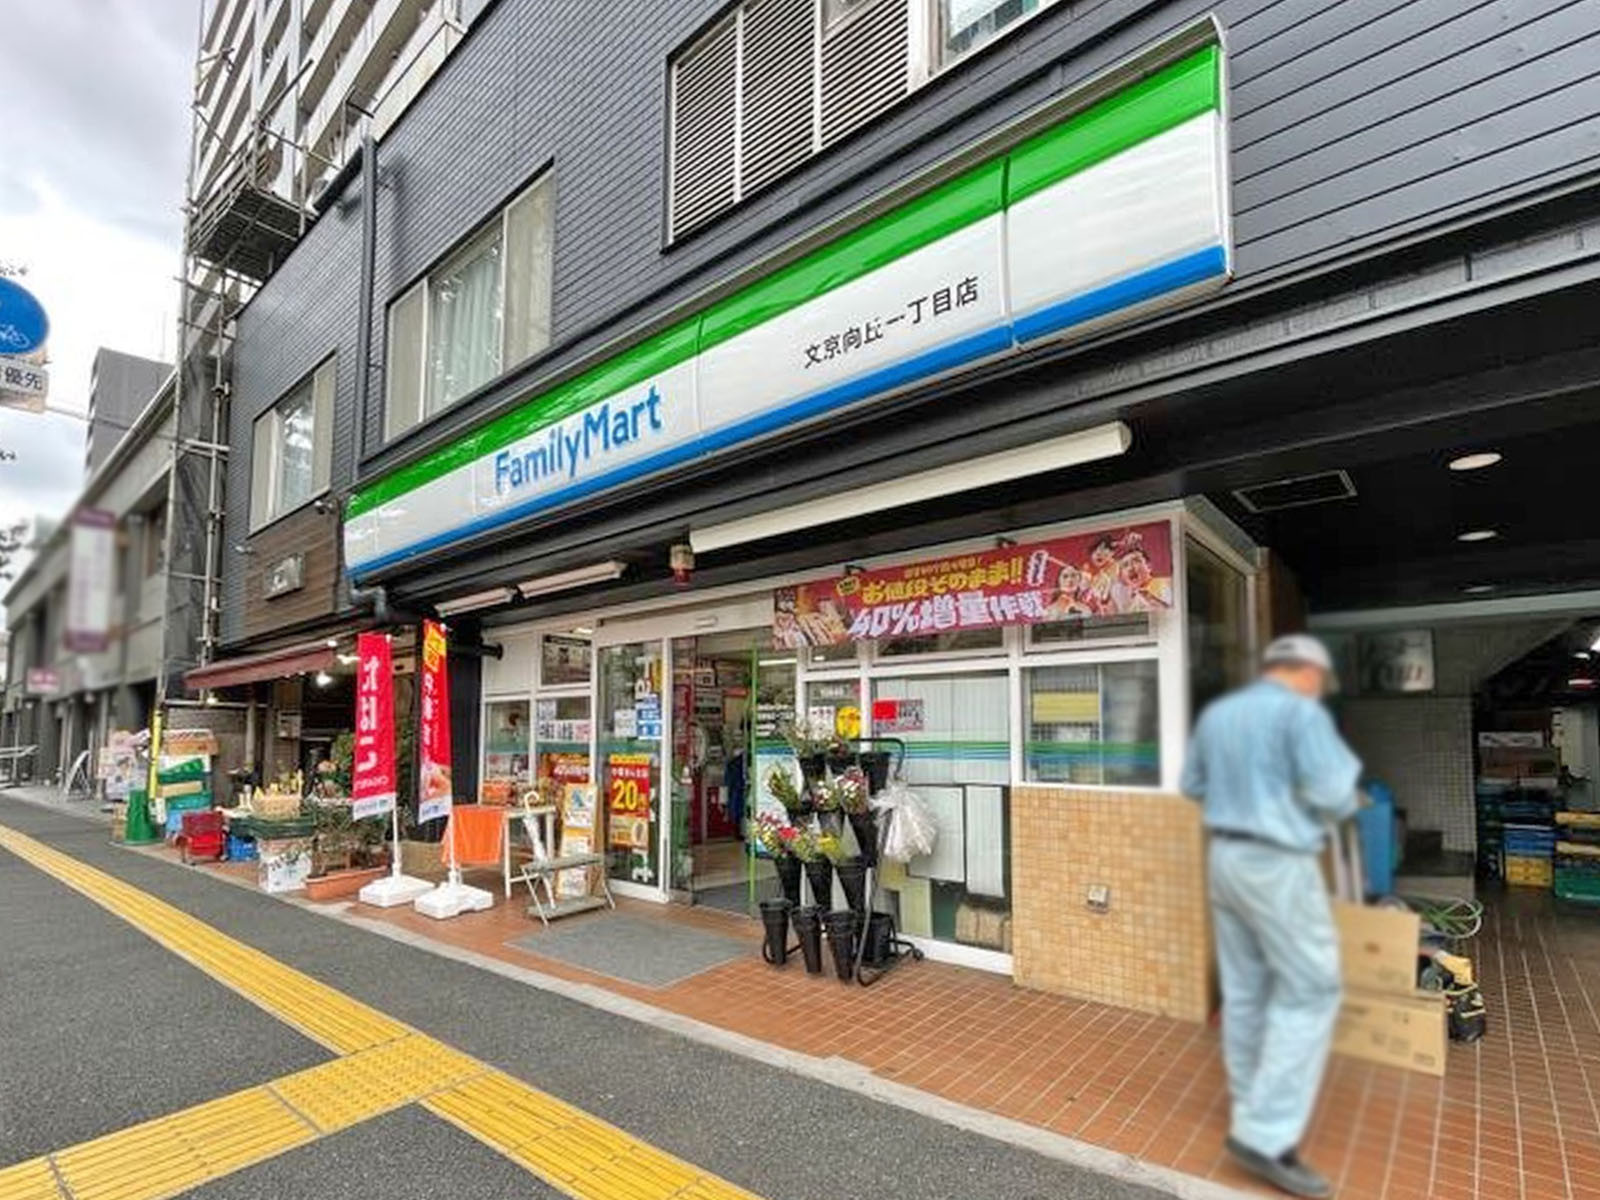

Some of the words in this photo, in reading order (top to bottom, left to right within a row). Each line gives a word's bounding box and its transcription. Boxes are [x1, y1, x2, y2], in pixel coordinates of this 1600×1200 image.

[804, 275, 979, 369] 文京向丘一丁目店
[0, 365, 43, 391] 優先
[494, 384, 662, 495] FamilyMart
